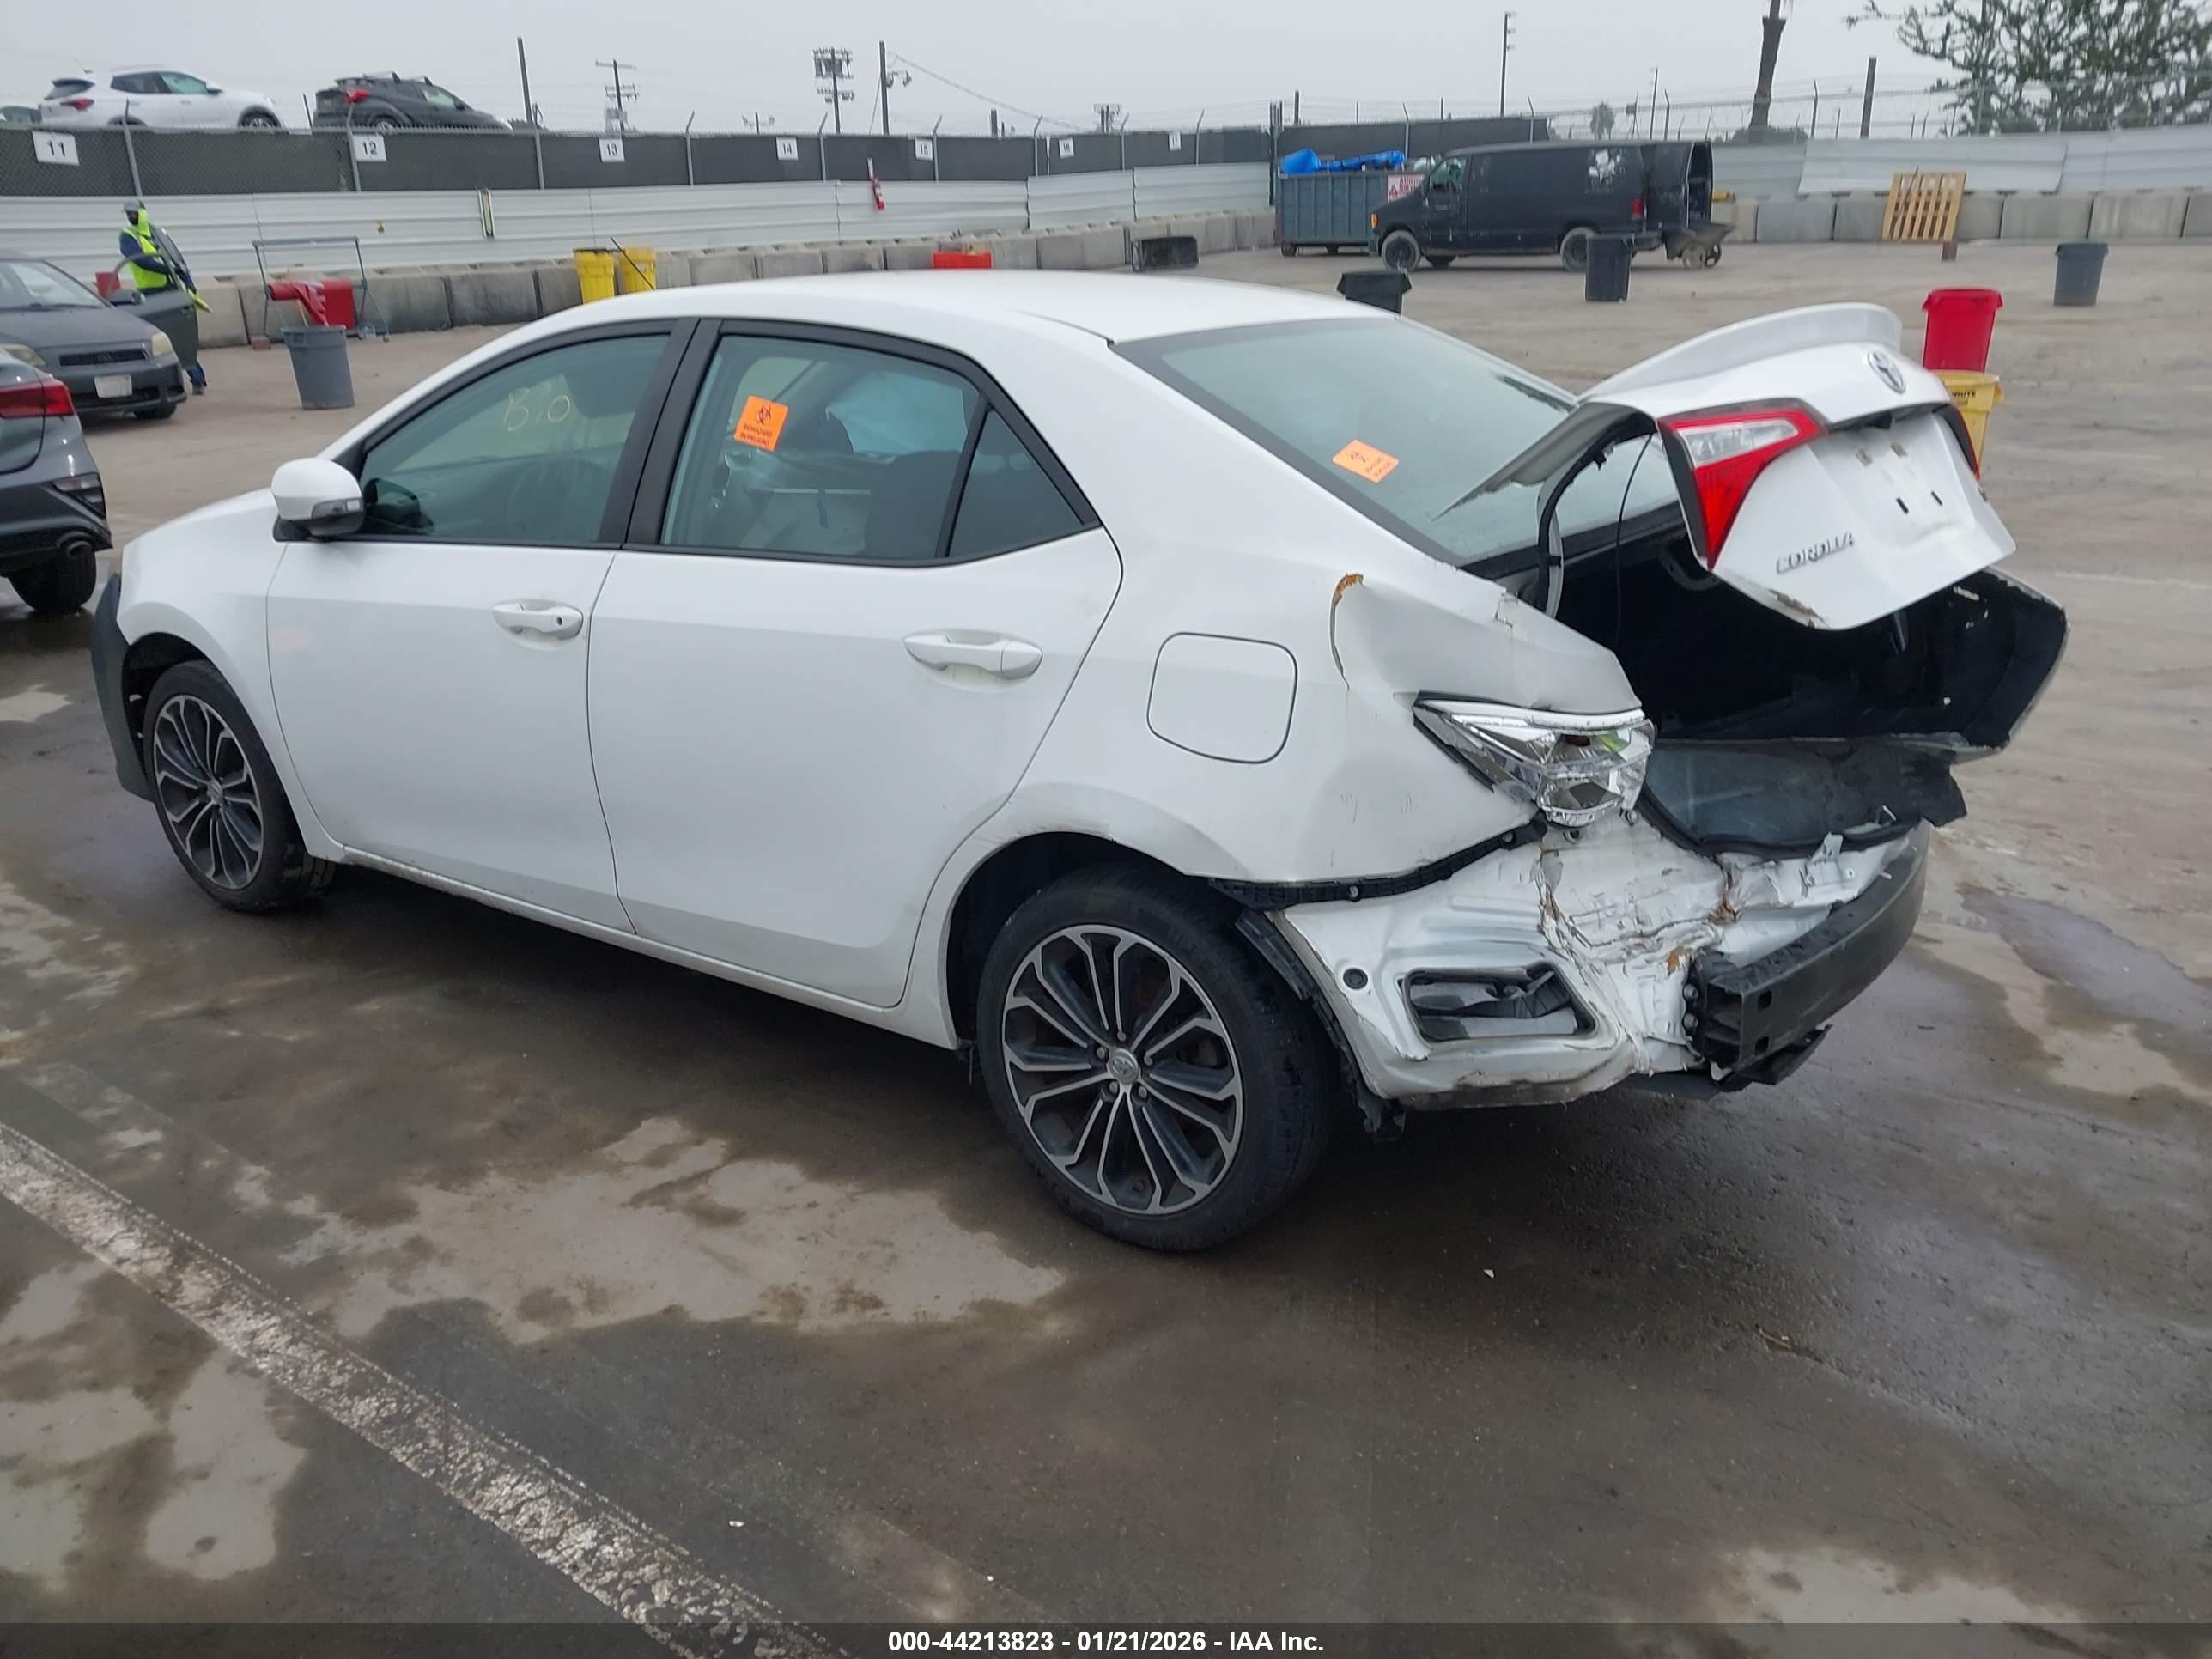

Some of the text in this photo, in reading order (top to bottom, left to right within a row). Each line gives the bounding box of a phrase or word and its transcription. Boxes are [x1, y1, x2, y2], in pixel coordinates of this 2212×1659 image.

[46, 140, 66, 156] 11
[362, 141, 378, 155] 12
[606, 143, 618, 156] 13
[782, 143, 792, 155] 14
[1776, 532, 1853, 574] COROLLA
